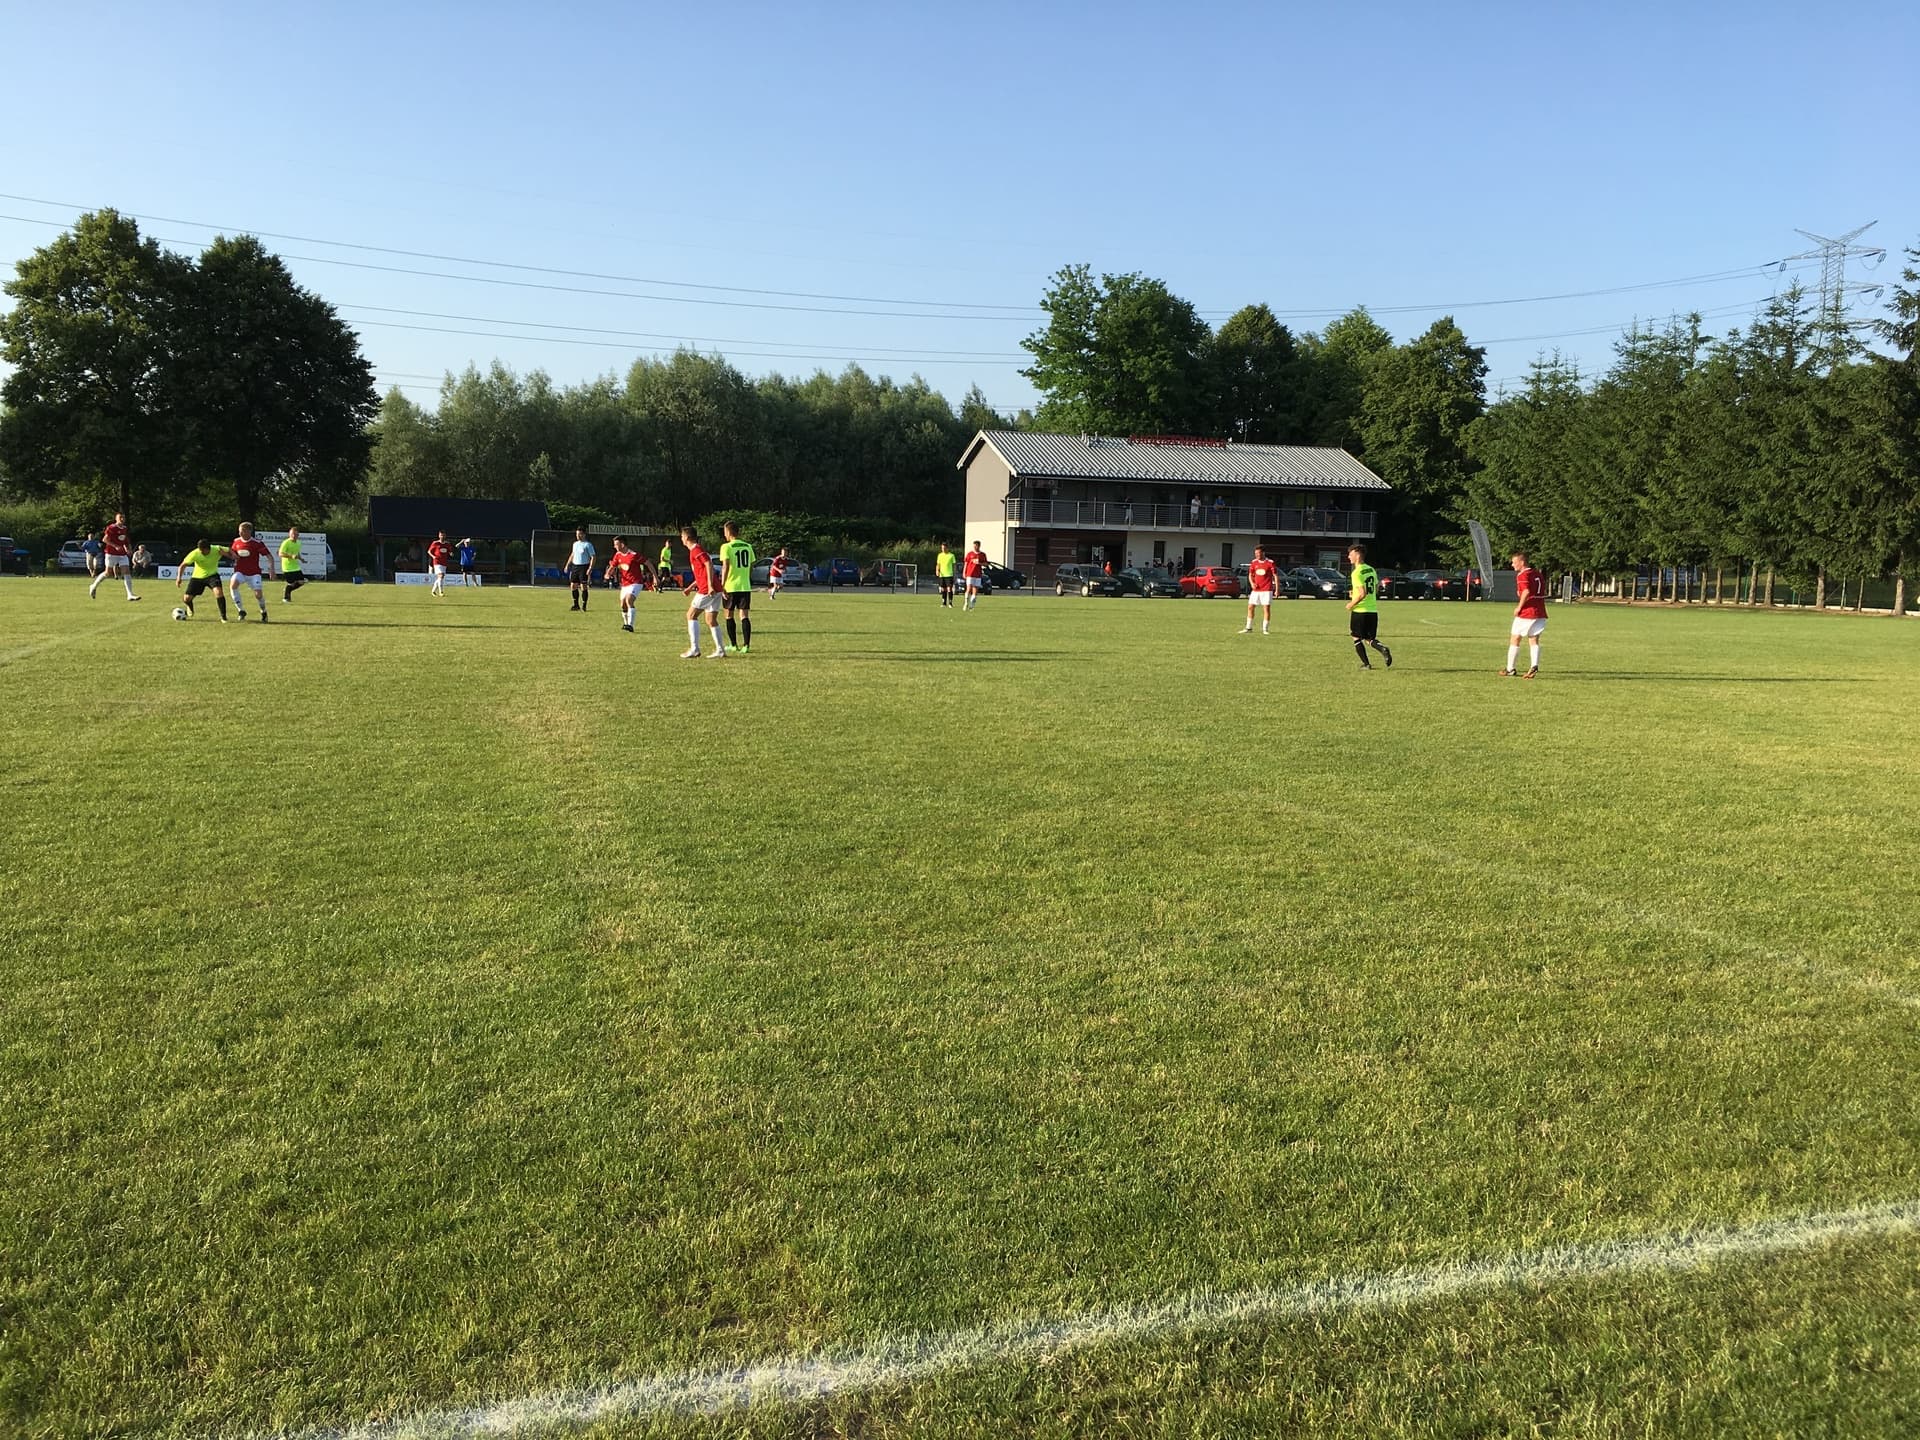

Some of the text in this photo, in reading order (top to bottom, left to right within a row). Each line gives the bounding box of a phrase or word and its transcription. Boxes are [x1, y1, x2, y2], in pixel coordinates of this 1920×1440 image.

[735, 550, 749, 568] 10
[1364, 576, 1374, 594] 13
[1534, 577, 1541, 594] 7
